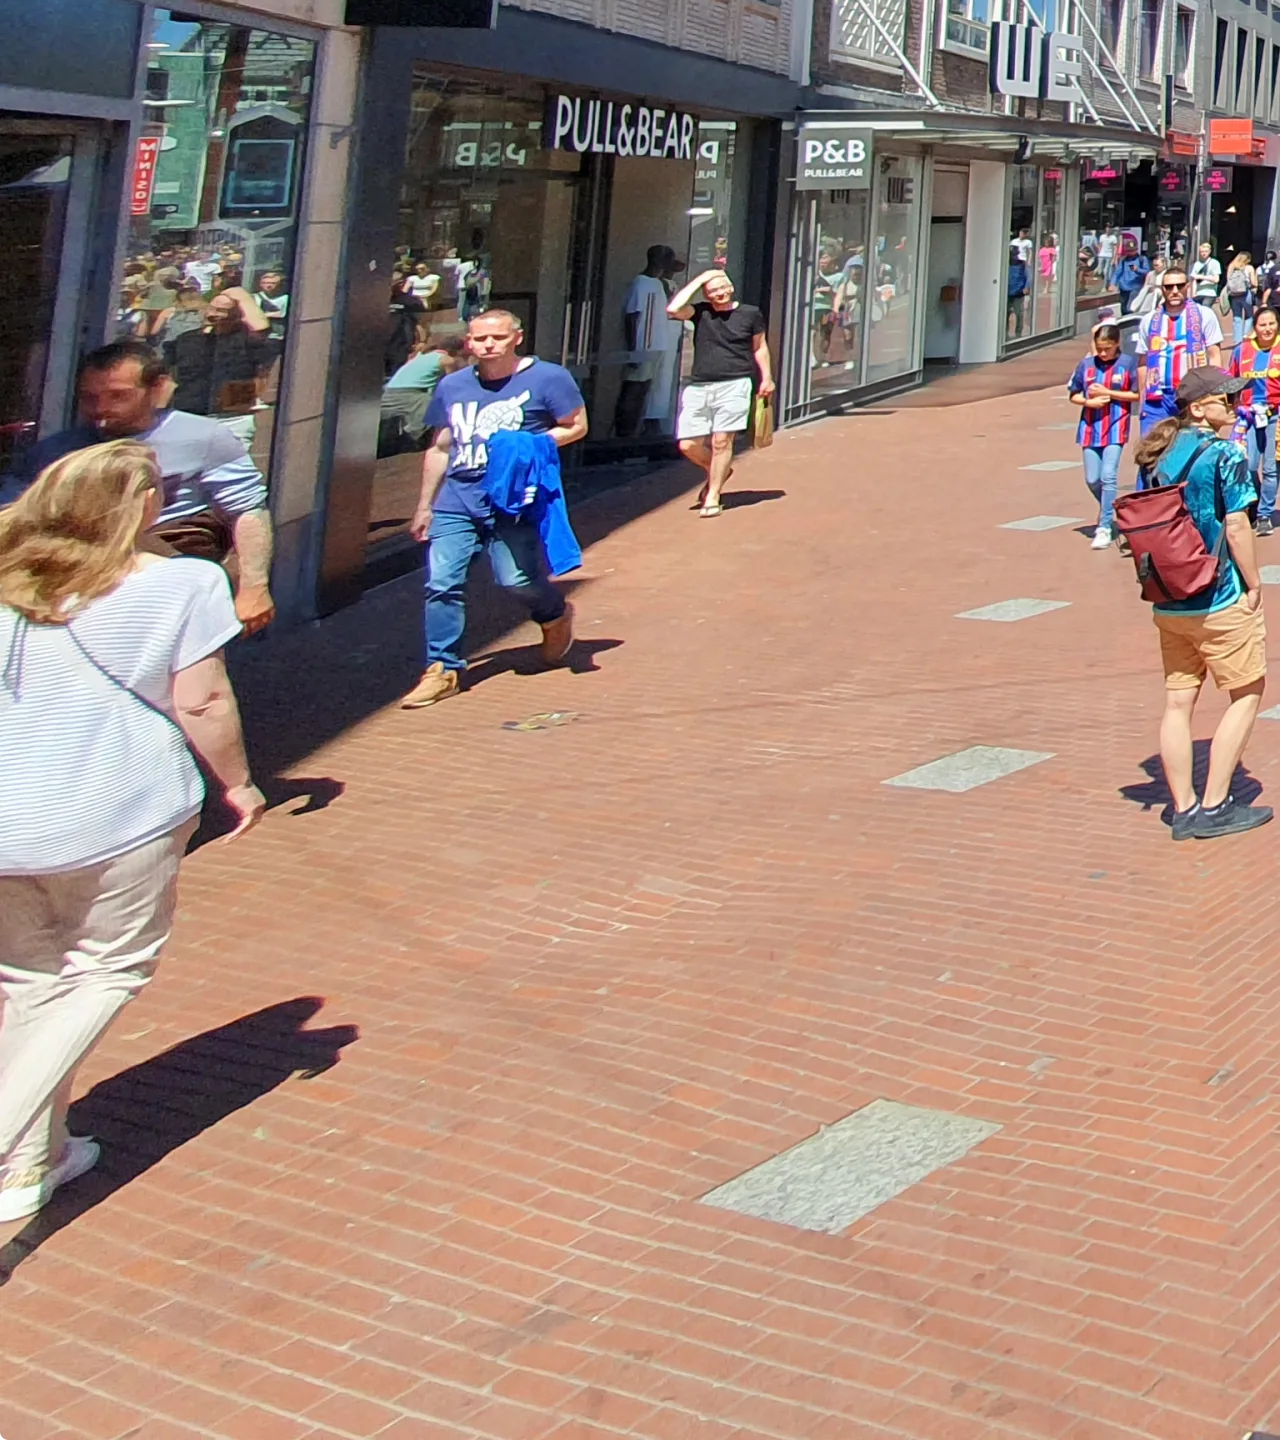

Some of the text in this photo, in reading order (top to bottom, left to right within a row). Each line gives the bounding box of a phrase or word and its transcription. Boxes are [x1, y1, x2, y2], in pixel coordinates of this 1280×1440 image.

[990, 21, 1082, 103] WE
[554, 94, 694, 160] PULL&BEAR
[804, 168, 863, 177] PULL&BEAR
[805, 139, 866, 164] P&B
